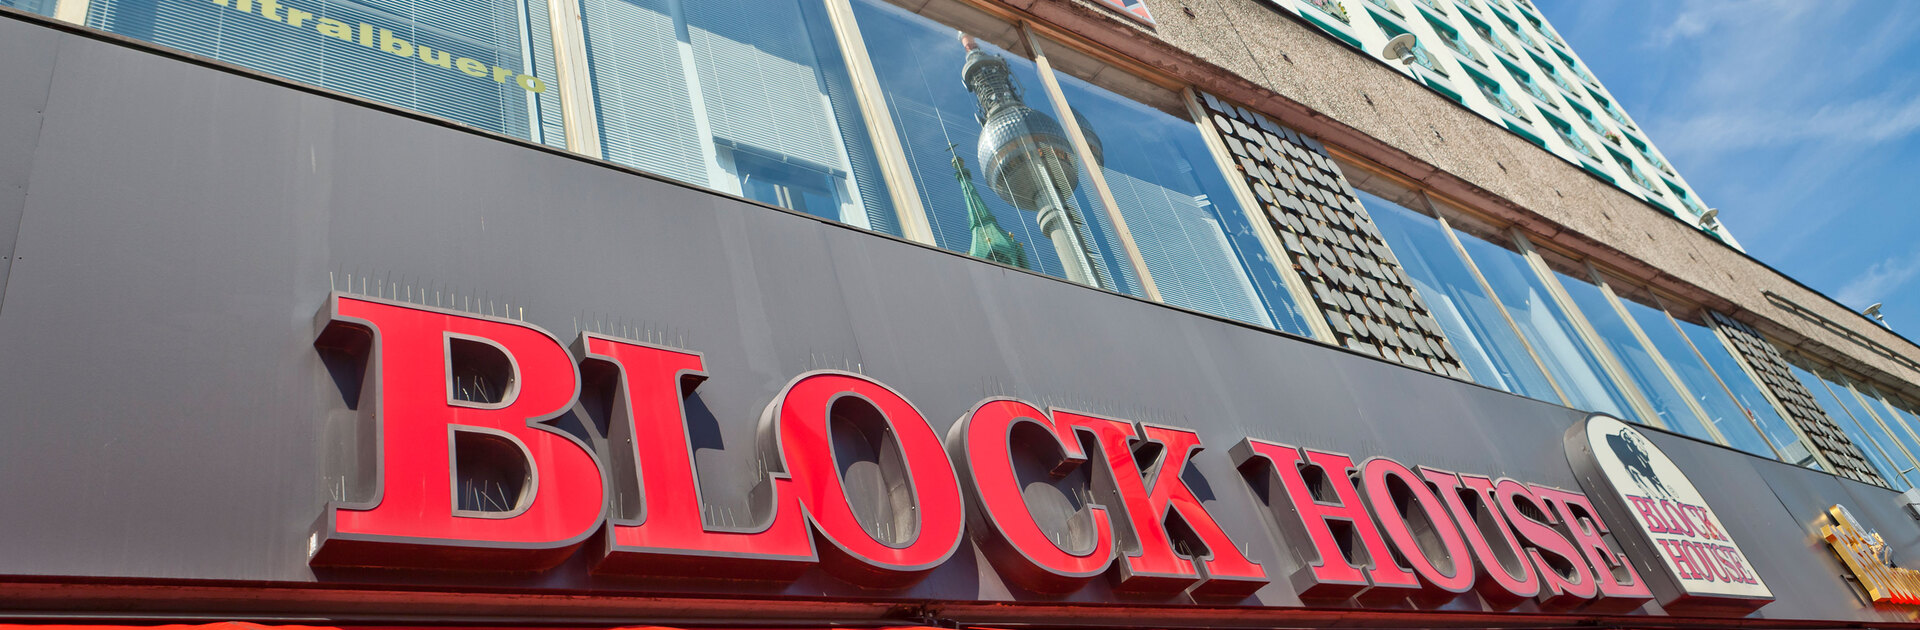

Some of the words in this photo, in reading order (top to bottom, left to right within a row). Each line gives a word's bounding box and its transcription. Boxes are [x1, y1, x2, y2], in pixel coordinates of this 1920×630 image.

[325, 290, 1269, 582] BLOCK
[1244, 436, 1655, 600] HOUSE
[1625, 493, 1729, 542] BLOCK
[1655, 538, 1759, 585] HOUSE
